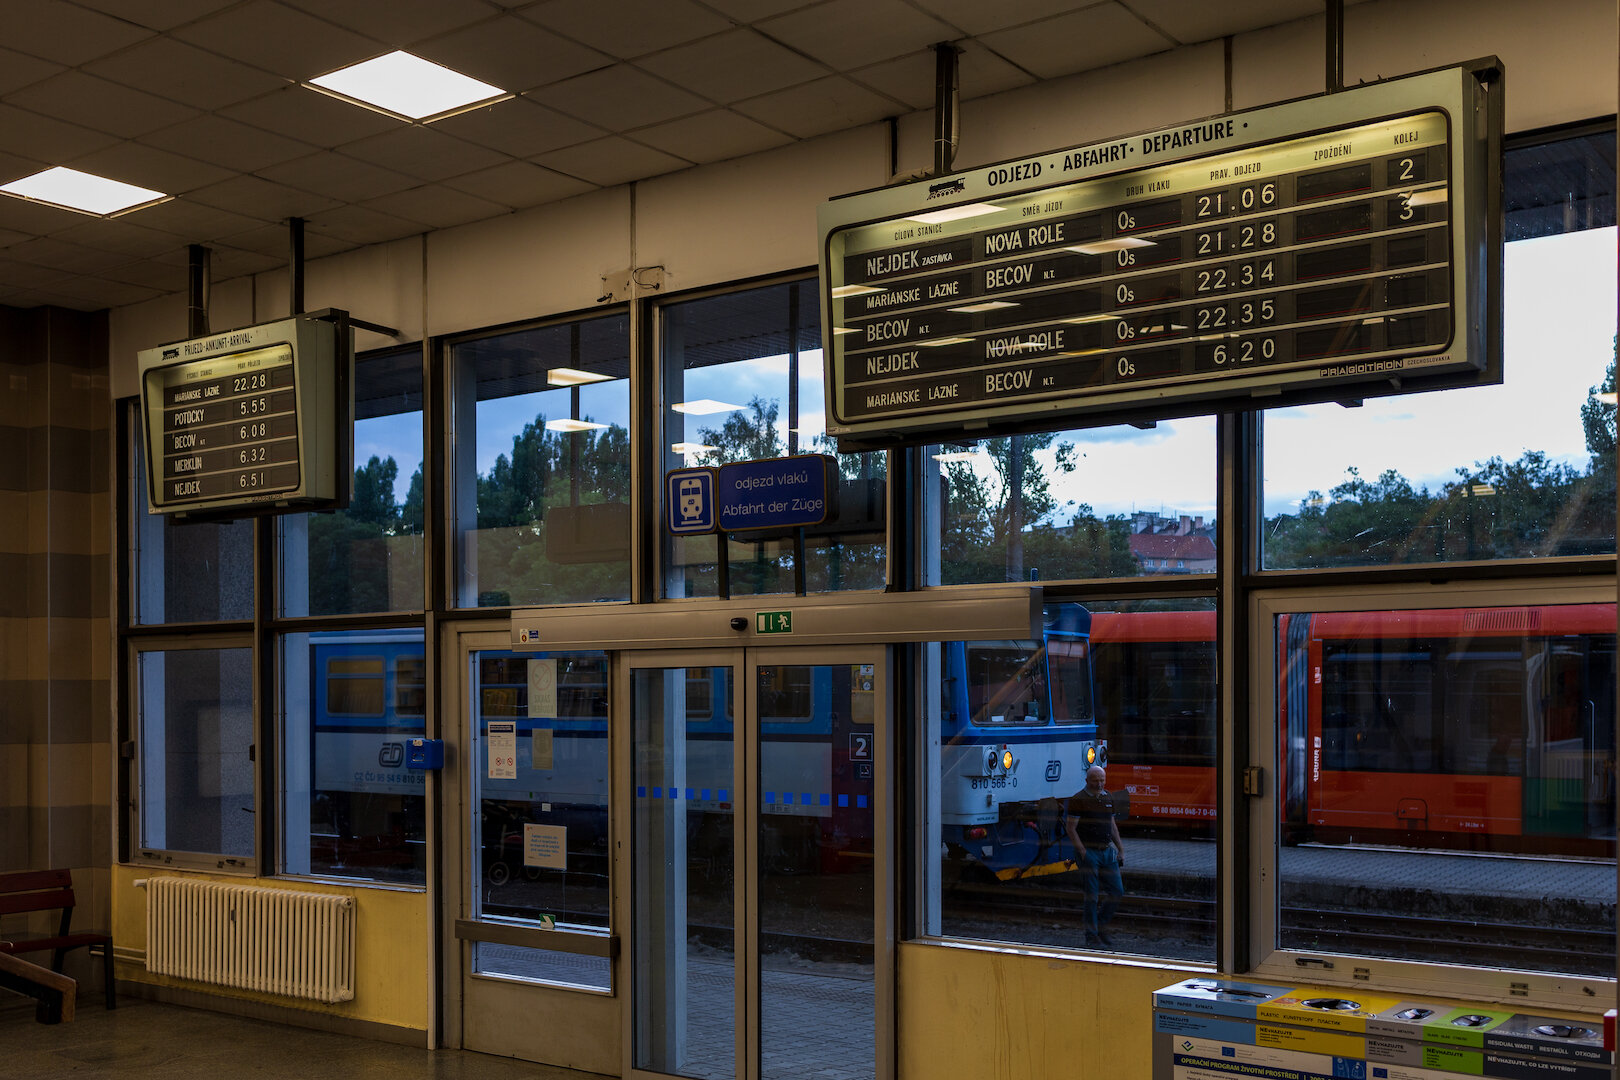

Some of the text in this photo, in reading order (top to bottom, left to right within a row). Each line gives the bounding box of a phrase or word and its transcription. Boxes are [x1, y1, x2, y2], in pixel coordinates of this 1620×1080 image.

[1393, 131, 1419, 146] KOLEJ
[987, 120, 1235, 187] ODJEZD ABFAHRT DEPARTURE
[1234, 162, 1262, 176] ODJEZD
[1400, 158, 1414, 181] 2
[1126, 180, 1171, 197] DRUH VLAKU
[1400, 192, 1414, 220] 3
[918, 224, 942, 237] STANICE
[1028, 222, 1065, 247] ROLE
[866, 249, 920, 276] NEJDEK
[1028, 329, 1065, 354] ROLE
[866, 350, 920, 376] NEJDEK
[1320, 356, 1450, 377] PRAGOTRON CZECHOSLOVAKIA
[174, 480, 201, 496] NEJDEK
[735, 470, 808, 492] odjezd vlaků
[722, 497, 824, 517] Abfahrt der Züge
[856, 737, 868, 757] 2
[402, 775, 414, 784] 810
[972, 778, 988, 790] 810
[1260, 1011, 1314, 1023] PLASTIC KUNSTSTOFF
[1488, 1039, 1569, 1055] RESIDUAL WASTE RESTMÜLL
[1180, 1056, 1210, 1068] OPERAČNÍ
[1210, 1061, 1241, 1072] PROGRAM
[1240, 1064, 1266, 1076] ŽIVOTNÍ
